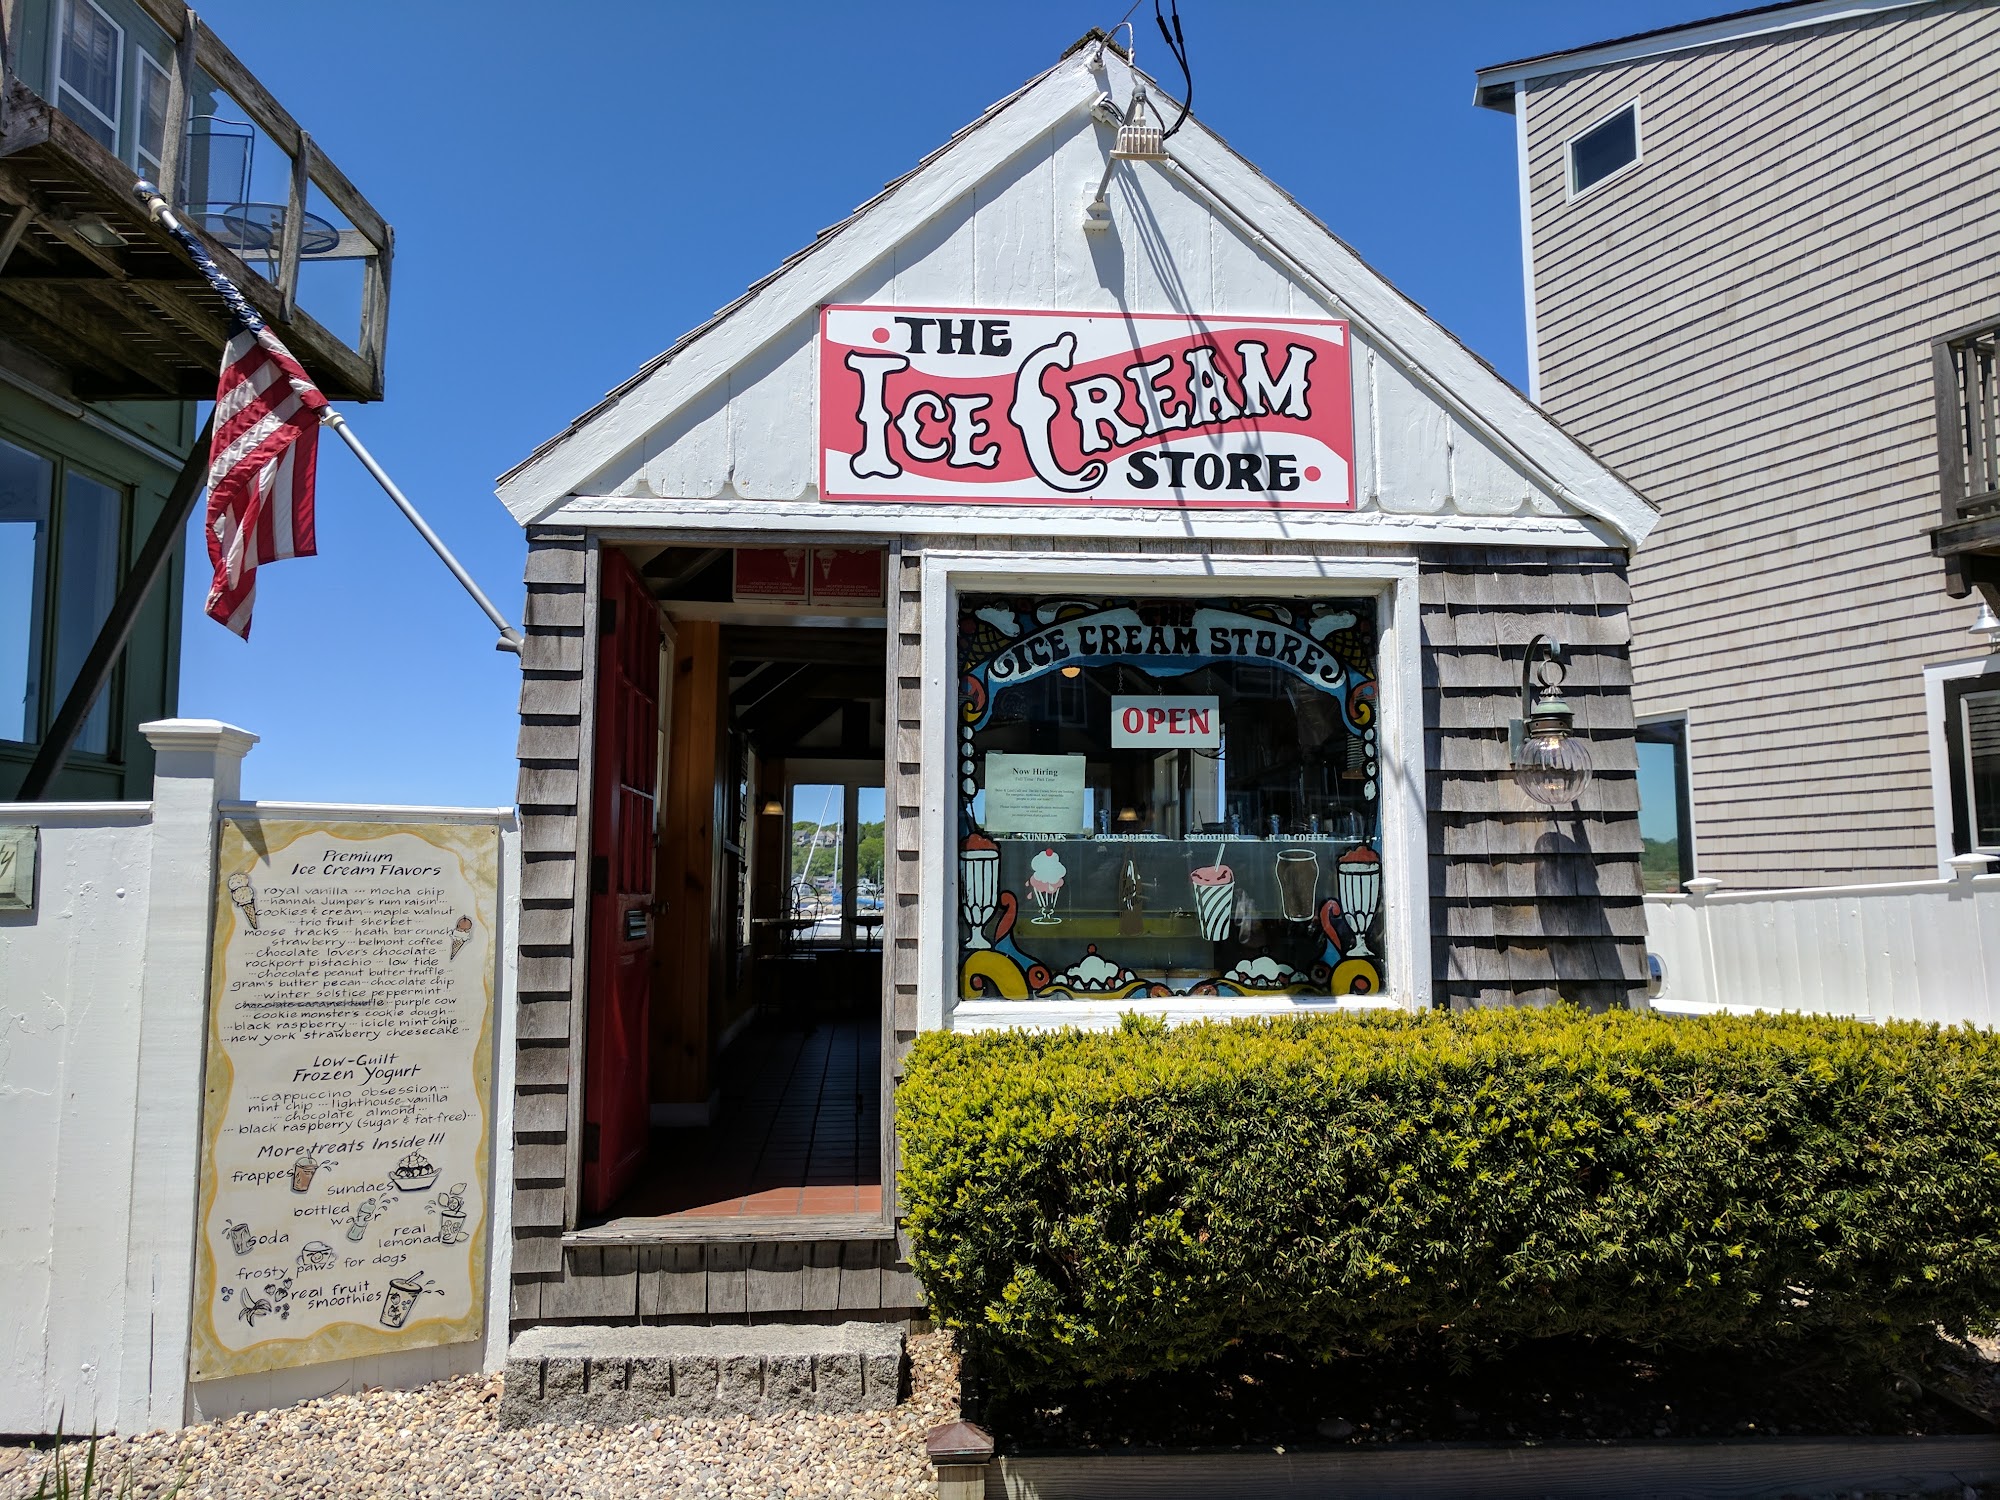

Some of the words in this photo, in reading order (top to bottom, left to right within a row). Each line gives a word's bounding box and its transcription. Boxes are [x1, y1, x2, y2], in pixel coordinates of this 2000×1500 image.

[895, 317, 1010, 355] THE
[845, 350, 999, 479] ICE
[1008, 332, 1317, 492] CREAM
[1126, 451, 1300, 491] STORE
[1012, 629, 1070, 675] ICE
[1078, 625, 1199, 656] CREAM
[1209, 627, 1326, 674] STORE
[1122, 707, 1210, 734] OPEN
[1013, 767, 1030, 775] Now
[1033, 768, 1058, 776] Hiring
[1094, 834, 1119, 842] COLD
[1122, 834, 1159, 842] DRINKS
[1294, 834, 1329, 842] COFFEE
[322, 850, 393, 862] Premium
[291, 863, 316, 875] Ice
[323, 864, 375, 876] Cream
[380, 865, 442, 876] Flavors
[264, 886, 300, 898] royal
[304, 887, 348, 895] vanilla
[370, 887, 411, 895] mocha
[417, 887, 445, 900] chip
[270, 897, 316, 905] hannah
[404, 898, 437, 906] raisin
[255, 907, 307, 916] cookies
[373, 909, 410, 919] maple
[413, 906, 455, 915] walnut
[300, 917, 322, 926] trio
[326, 917, 354, 926] fruit
[361, 917, 412, 926] sherbet
[244, 929, 286, 937] moose
[294, 928, 339, 936] tracks
[355, 927, 388, 936] heath
[393, 927, 413, 935] bar
[415, 927, 454, 935] crunch
[272, 938, 346, 949] strawberry
[358, 938, 404, 946] belmont
[408, 938, 443, 946] coffee
[256, 946, 319, 957] chocolate
[327, 948, 368, 956] lover's
[372, 946, 437, 956] chocolate
[245, 959, 305, 970] rockport
[309, 958, 372, 970] pistachio
[388, 957, 408, 966] low
[414, 957, 439, 966] tide
[257, 969, 319, 978] chocolate
[324, 968, 364, 979] peanut
[369, 968, 405, 976] butter
[407, 967, 444, 976] truffle
[230, 980, 274, 991] gram's
[279, 979, 318, 988] butter
[323, 980, 361, 989] pecan
[370, 977, 426, 986] chocolate
[430, 976, 455, 989] chip
[263, 989, 310, 999] winter
[316, 988, 366, 997] solstice
[371, 987, 441, 999] peppermint
[394, 998, 431, 1009] purple
[253, 1011, 298, 1019] cookie
[301, 1009, 359, 1018] monster's
[410, 1008, 446, 1018] dough
[234, 1021, 271, 1030] black
[276, 1020, 346, 1032] raspberry
[361, 1019, 395, 1027] icicle
[399, 1018, 429, 1026] mint
[431, 1017, 458, 1028] chip
[231, 1034, 259, 1043] new
[259, 1032, 297, 1046] york
[303, 1029, 381, 1041] strawberry
[386, 1027, 459, 1037] cheesecake
[313, 1053, 399, 1067] Low-Guilt
[292, 1069, 354, 1082] Frozen
[357, 1064, 422, 1086] Yogurt
[260, 1090, 352, 1104] cappuccino
[361, 1084, 437, 1096] obsession
[248, 1102, 280, 1113] mint
[285, 1101, 313, 1114] chip
[332, 1097, 401, 1111] lighthouse
[407, 1093, 448, 1104] vanilla
[284, 1110, 355, 1121] chocolate
[366, 1104, 416, 1116] almond
[239, 1123, 278, 1134] black
[283, 1119, 353, 1134] raspberry
[257, 1144, 305, 1158] More
[311, 1139, 364, 1154] treats
[231, 1168, 294, 1185] frappes
[327, 1181, 394, 1195] sundaes
[293, 1202, 350, 1217] bottled
[330, 1212, 382, 1225] water
[393, 1224, 426, 1236] real
[248, 1230, 290, 1246] soda
[379, 1233, 451, 1248] lemonade
[235, 1267, 289, 1280] frosty
[295, 1262, 335, 1279] paws
[344, 1257, 366, 1268] for
[372, 1252, 407, 1267] dogs
[291, 1285, 323, 1300] real
[332, 1281, 370, 1294] fruit
[308, 1291, 382, 1309] smoothies
